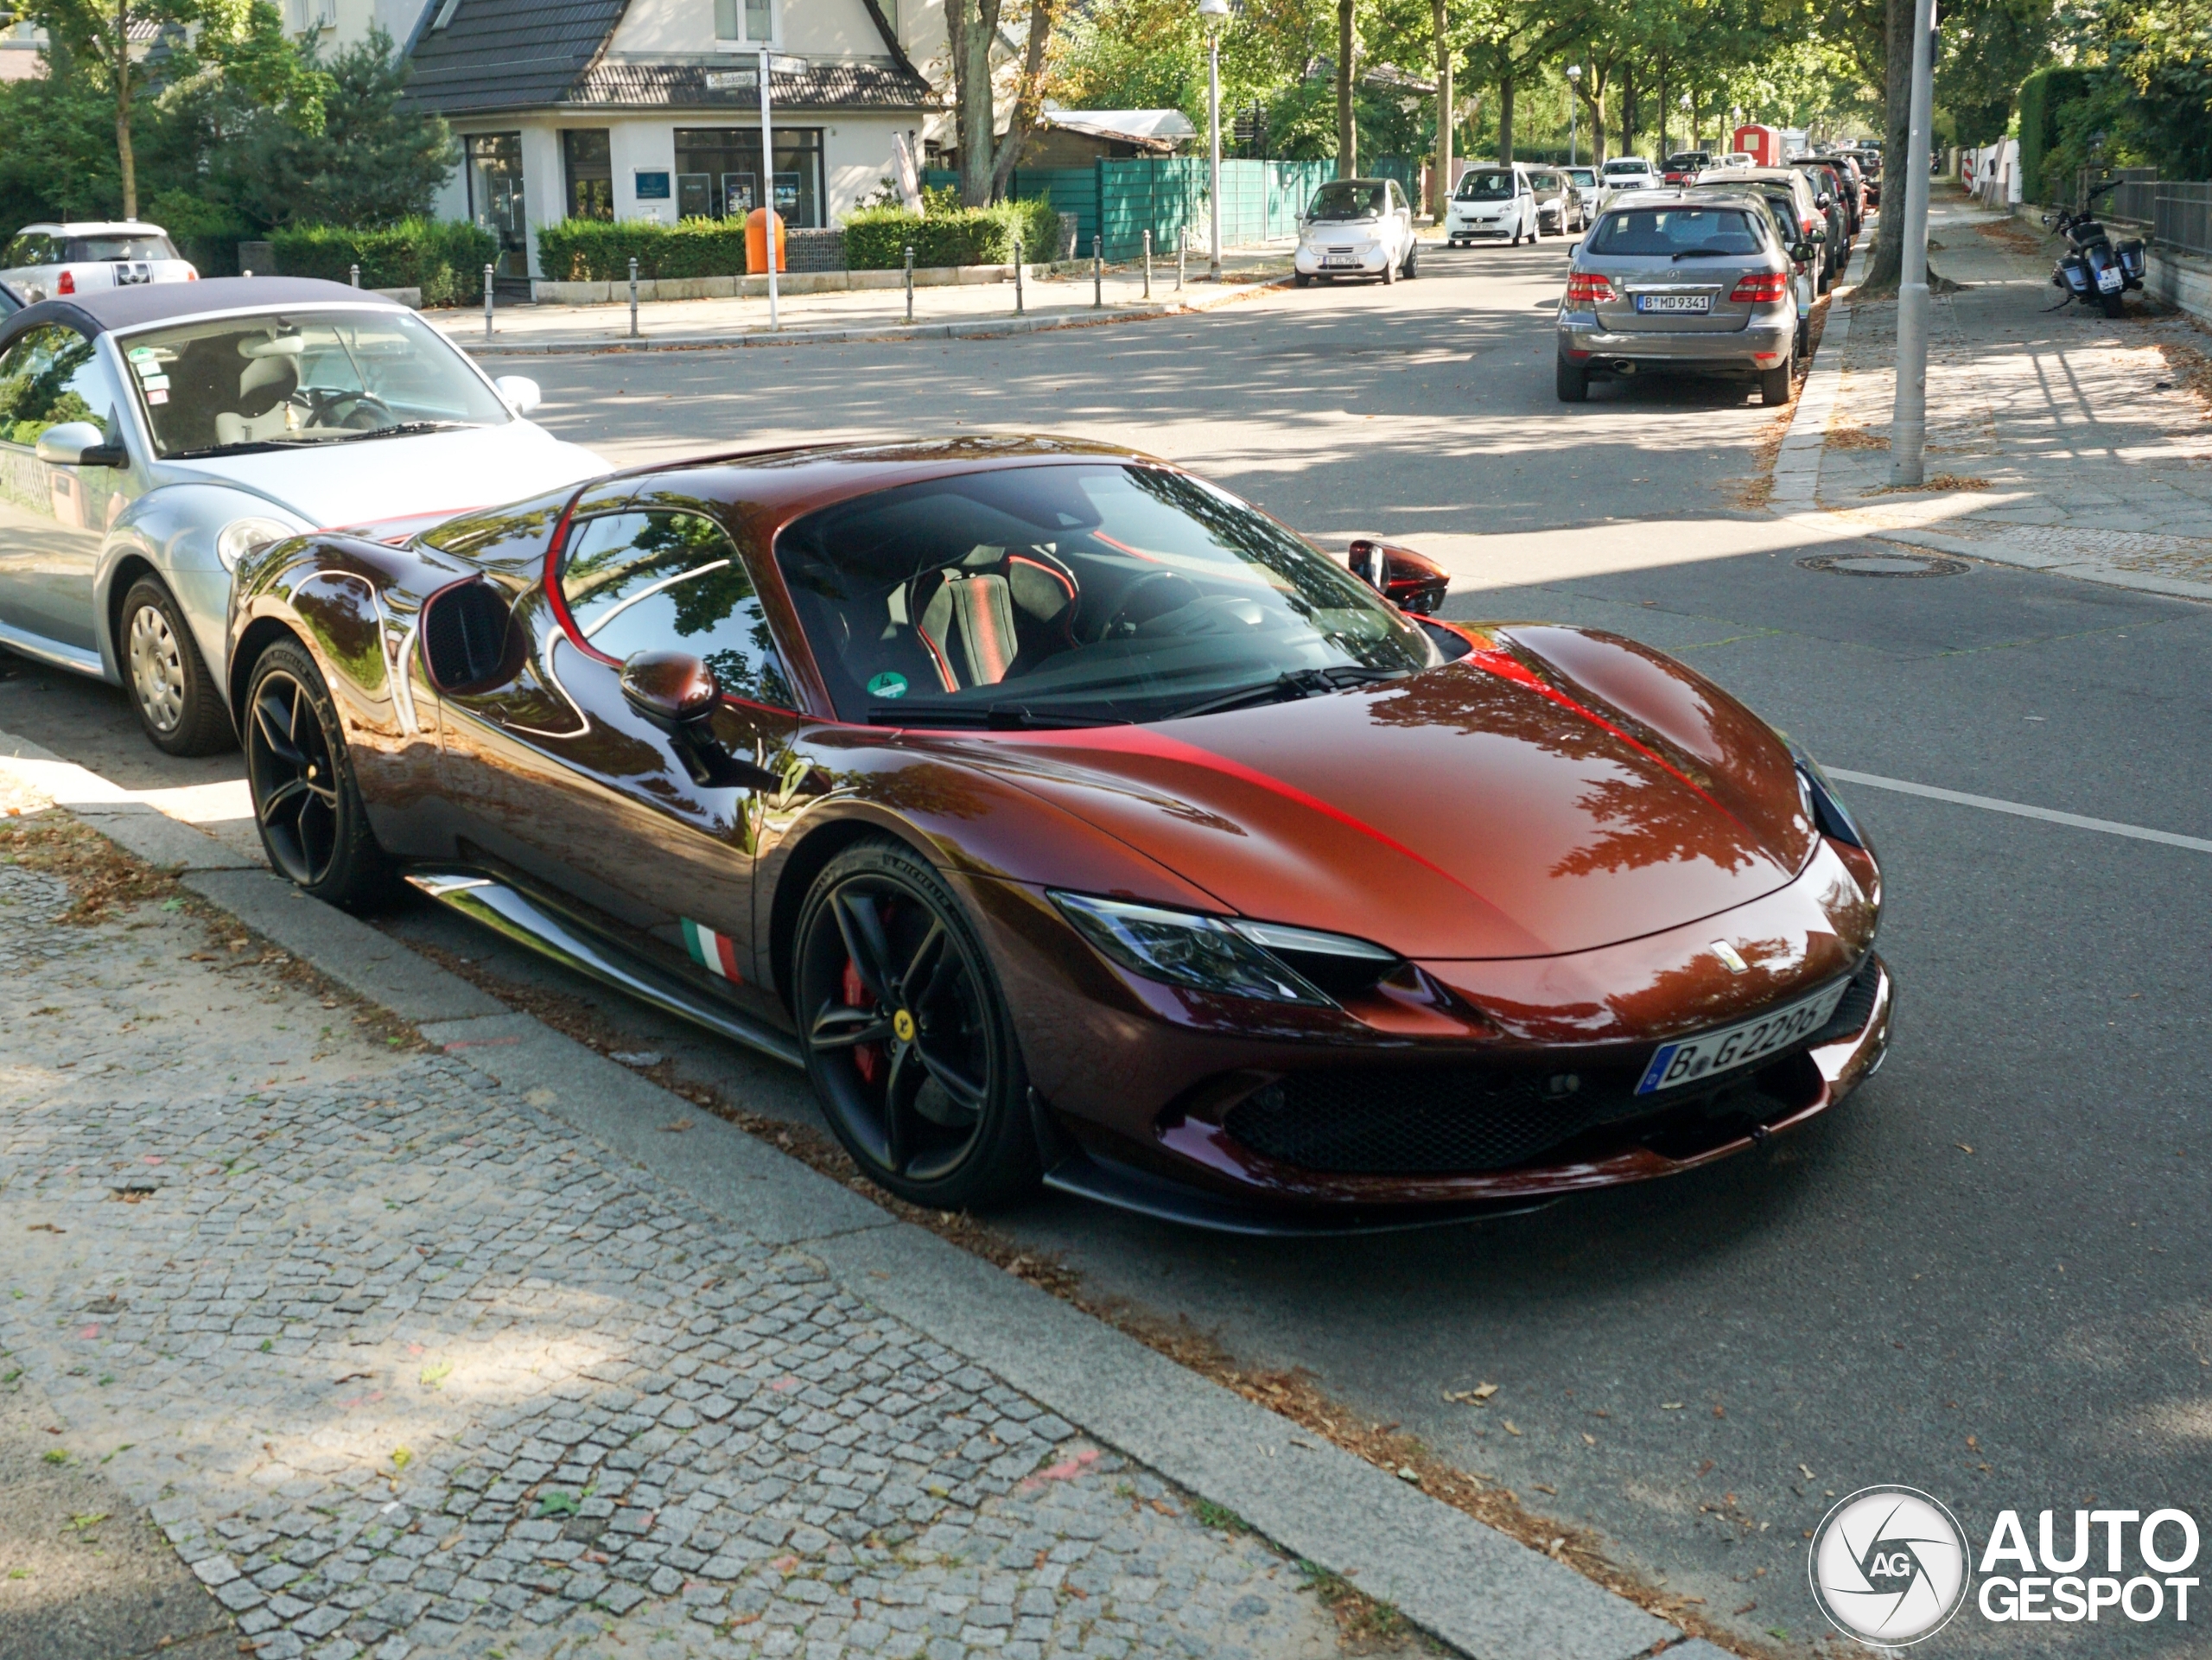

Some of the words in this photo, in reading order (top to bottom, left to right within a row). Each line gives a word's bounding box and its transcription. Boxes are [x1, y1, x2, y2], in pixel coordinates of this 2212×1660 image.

[1645, 297, 1652, 308] B
[1660, 297, 1675, 308] MD
[1678, 297, 1707, 308] 9341
[880, 674, 893, 686] 4
[892, 858, 951, 908] MICHELIN
[1665, 1046, 1697, 1081] B
[1713, 1032, 1745, 1068] G
[1739, 1001, 1819, 1059] 2296
